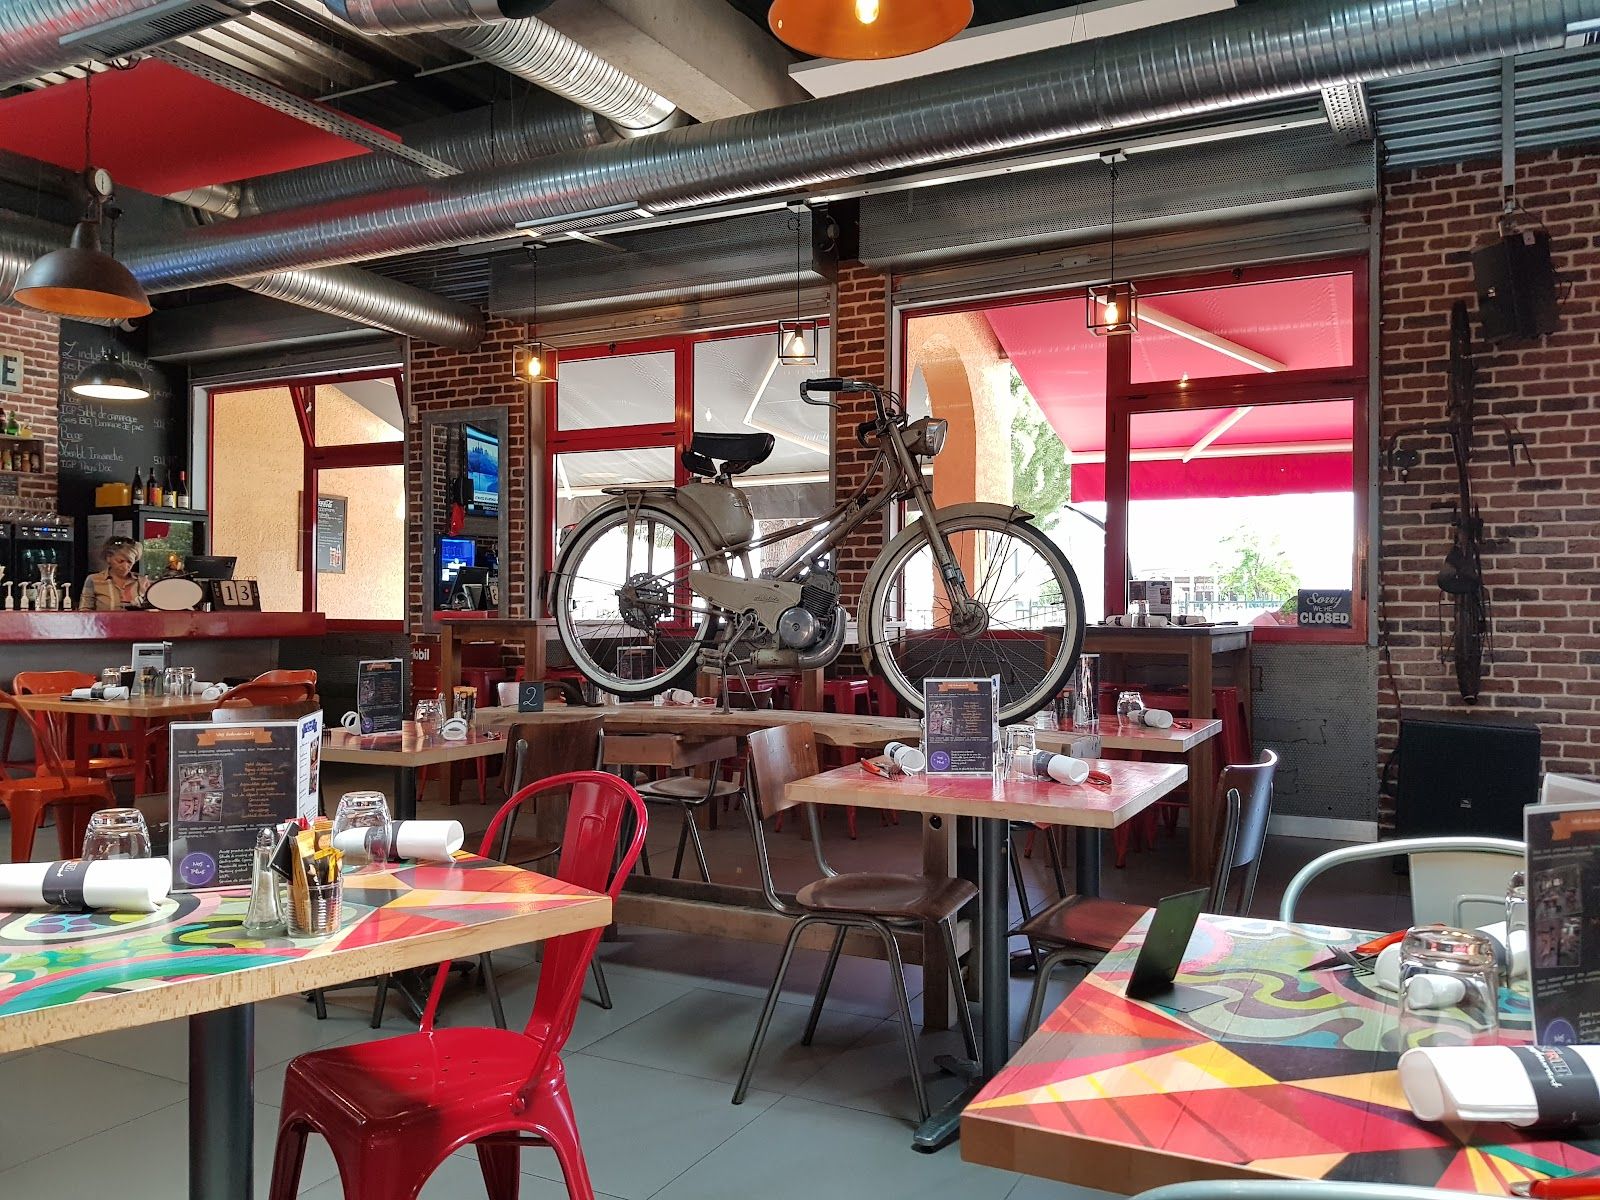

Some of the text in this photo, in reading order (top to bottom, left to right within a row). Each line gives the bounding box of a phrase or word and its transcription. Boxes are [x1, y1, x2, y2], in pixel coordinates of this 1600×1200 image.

[2, 355, 17, 386] E
[1306, 592, 1342, 609] Sorry
[1300, 611, 1349, 624] CLOSED
[522, 686, 538, 706] 2
